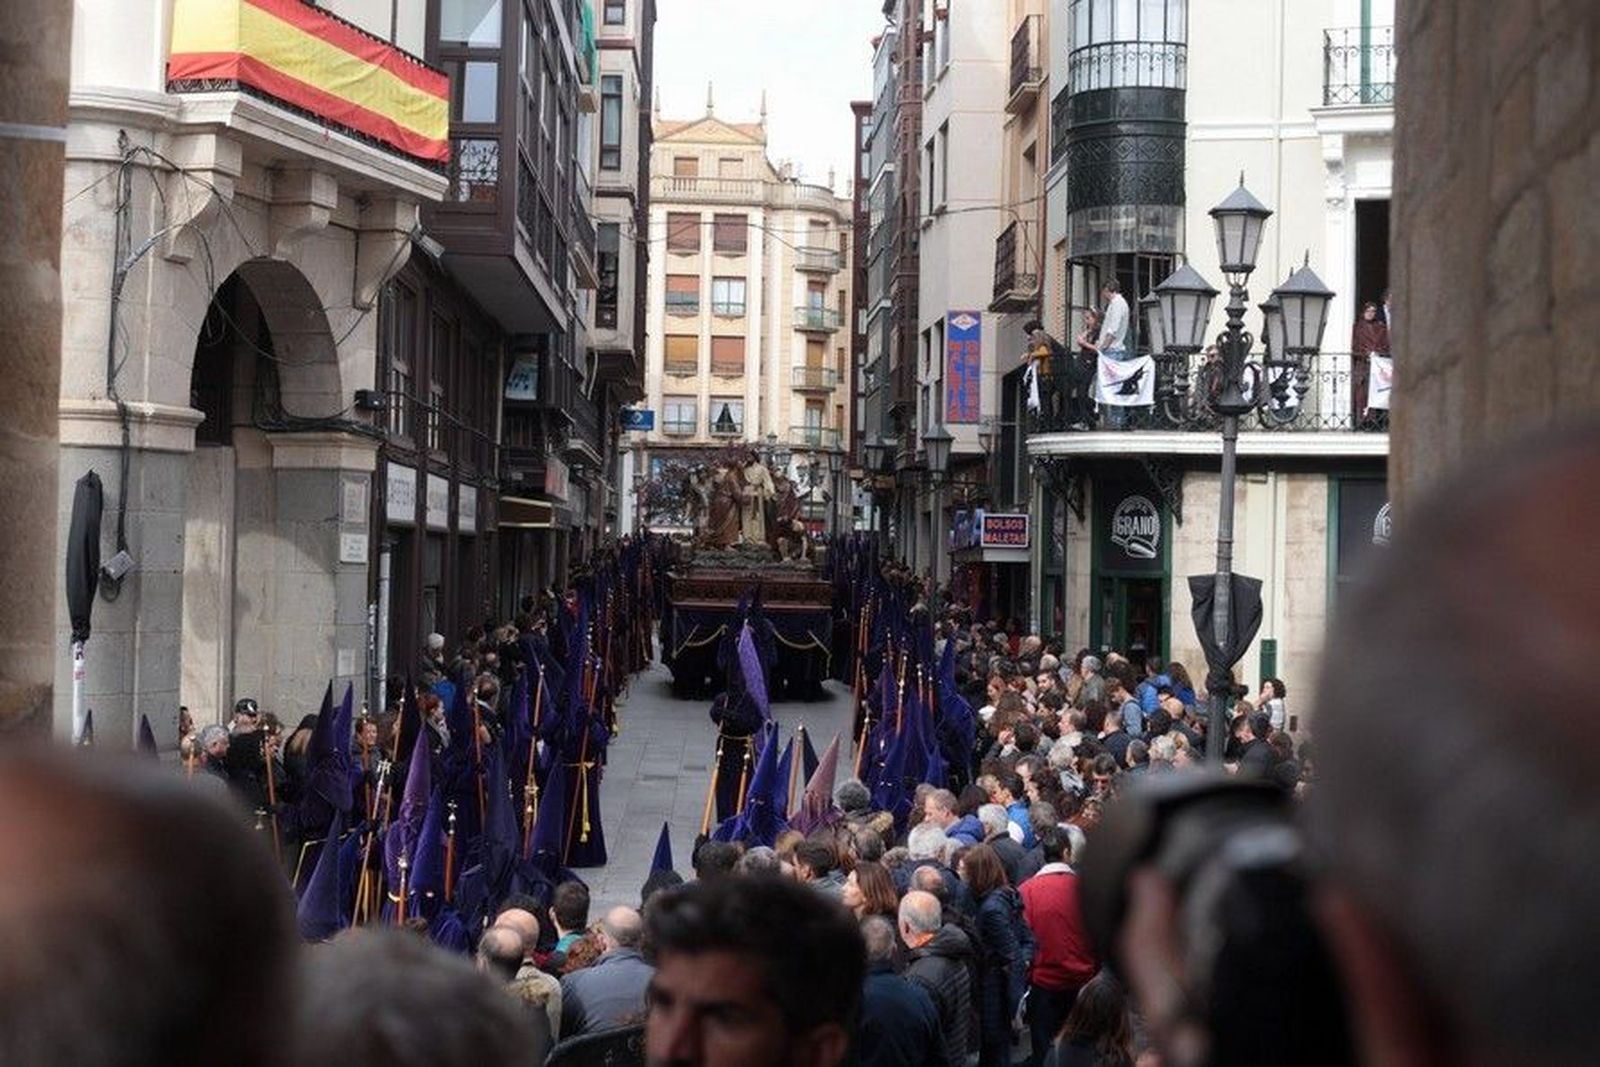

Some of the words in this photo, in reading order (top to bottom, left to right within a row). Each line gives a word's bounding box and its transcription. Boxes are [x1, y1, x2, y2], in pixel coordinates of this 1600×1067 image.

[986, 518, 1024, 530] BOLSOS
[1118, 515, 1153, 536] GRANO
[984, 533, 1026, 545] MALETAS
